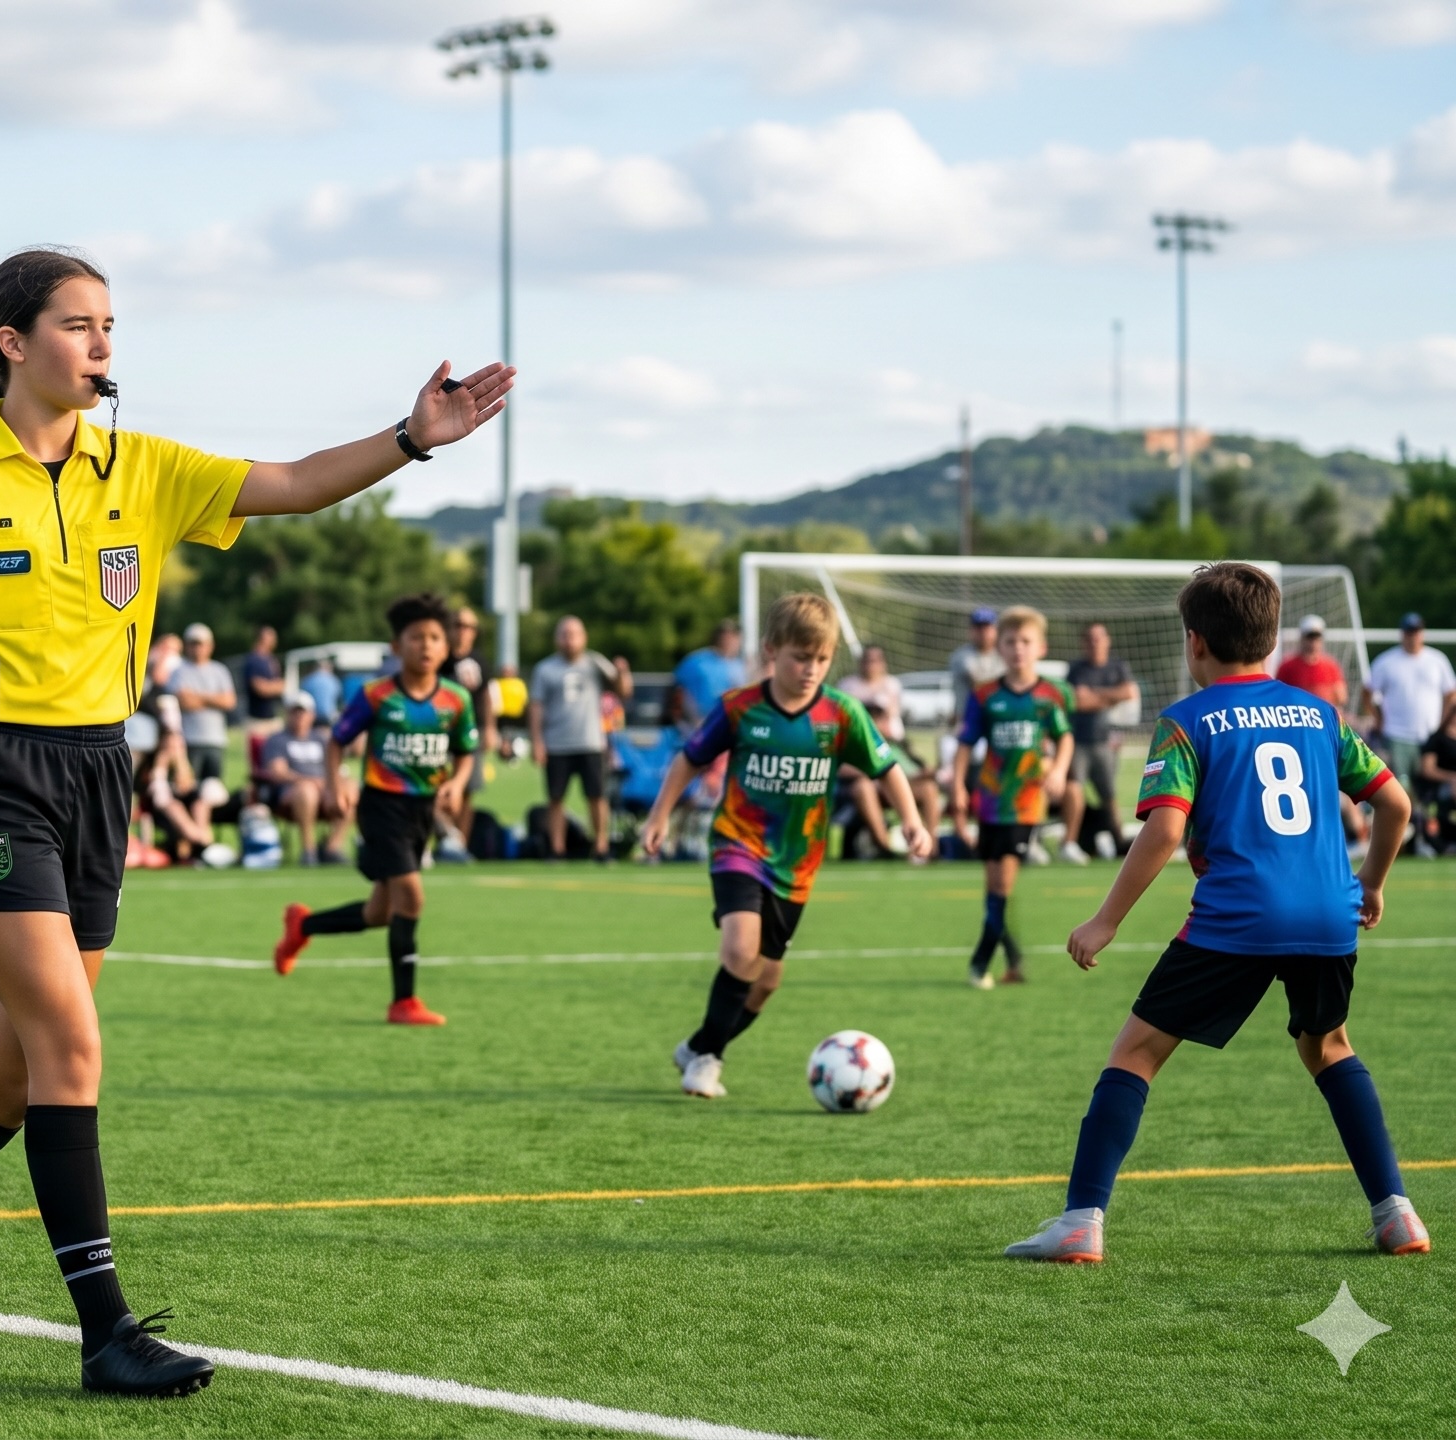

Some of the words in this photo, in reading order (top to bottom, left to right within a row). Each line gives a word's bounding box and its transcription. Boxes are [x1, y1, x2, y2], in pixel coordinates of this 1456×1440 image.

[1201, 709, 1234, 736] TX
[1232, 705, 1324, 730] RANGERS
[745, 752, 832, 781] AUSTIN
[1254, 742, 1312, 836] 8
